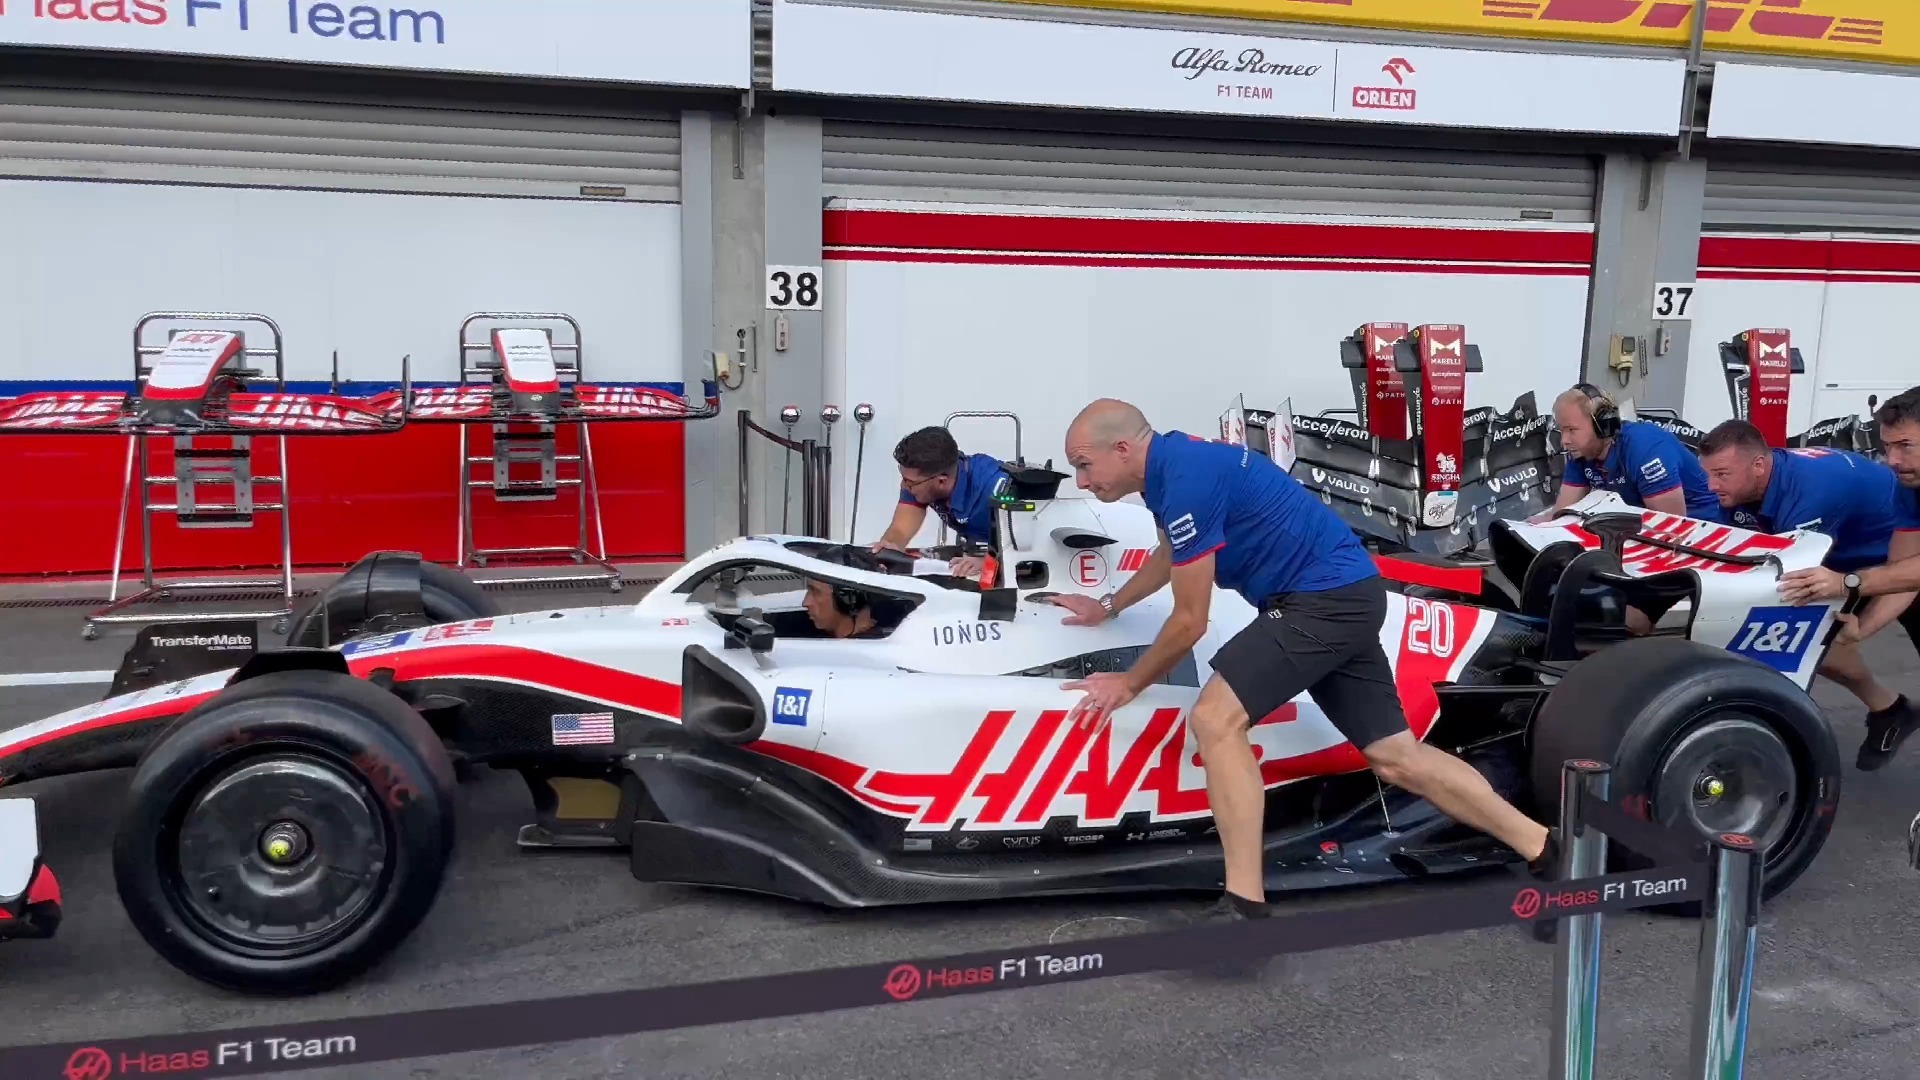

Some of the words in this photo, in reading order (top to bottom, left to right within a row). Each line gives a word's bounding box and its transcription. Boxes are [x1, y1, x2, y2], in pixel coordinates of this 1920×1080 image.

[1171, 47, 1233, 80] Alfa
[1237, 48, 1322, 77] Romeo
[1217, 84, 1231, 98] F1
[1237, 86, 1273, 100] TEAM
[1355, 89, 1413, 108] ORLEN
[770, 271, 818, 306] 38
[1656, 287, 1693, 316] 37
[1328, 475, 1370, 495] VAULD
[1501, 467, 1538, 486] VAULD
[1080, 555, 1098, 583] E
[150, 634, 252, 647] TransferMate
[933, 620, 1002, 646] IONOS
[1408, 597, 1454, 658] 20
[1740, 620, 1812, 655] 1&1
[776, 694, 807, 717] 1&1
[1545, 889, 1600, 908] Haas
[1603, 882, 1625, 901] F1
[1631, 877, 1687, 897] Team
[927, 966, 994, 989] Haas
[1000, 957, 1026, 980] F1
[1035, 952, 1103, 975] Team
[119, 1049, 209, 1074] Haas
[217, 1041, 253, 1065] F1
[264, 1035, 356, 1060] Team
